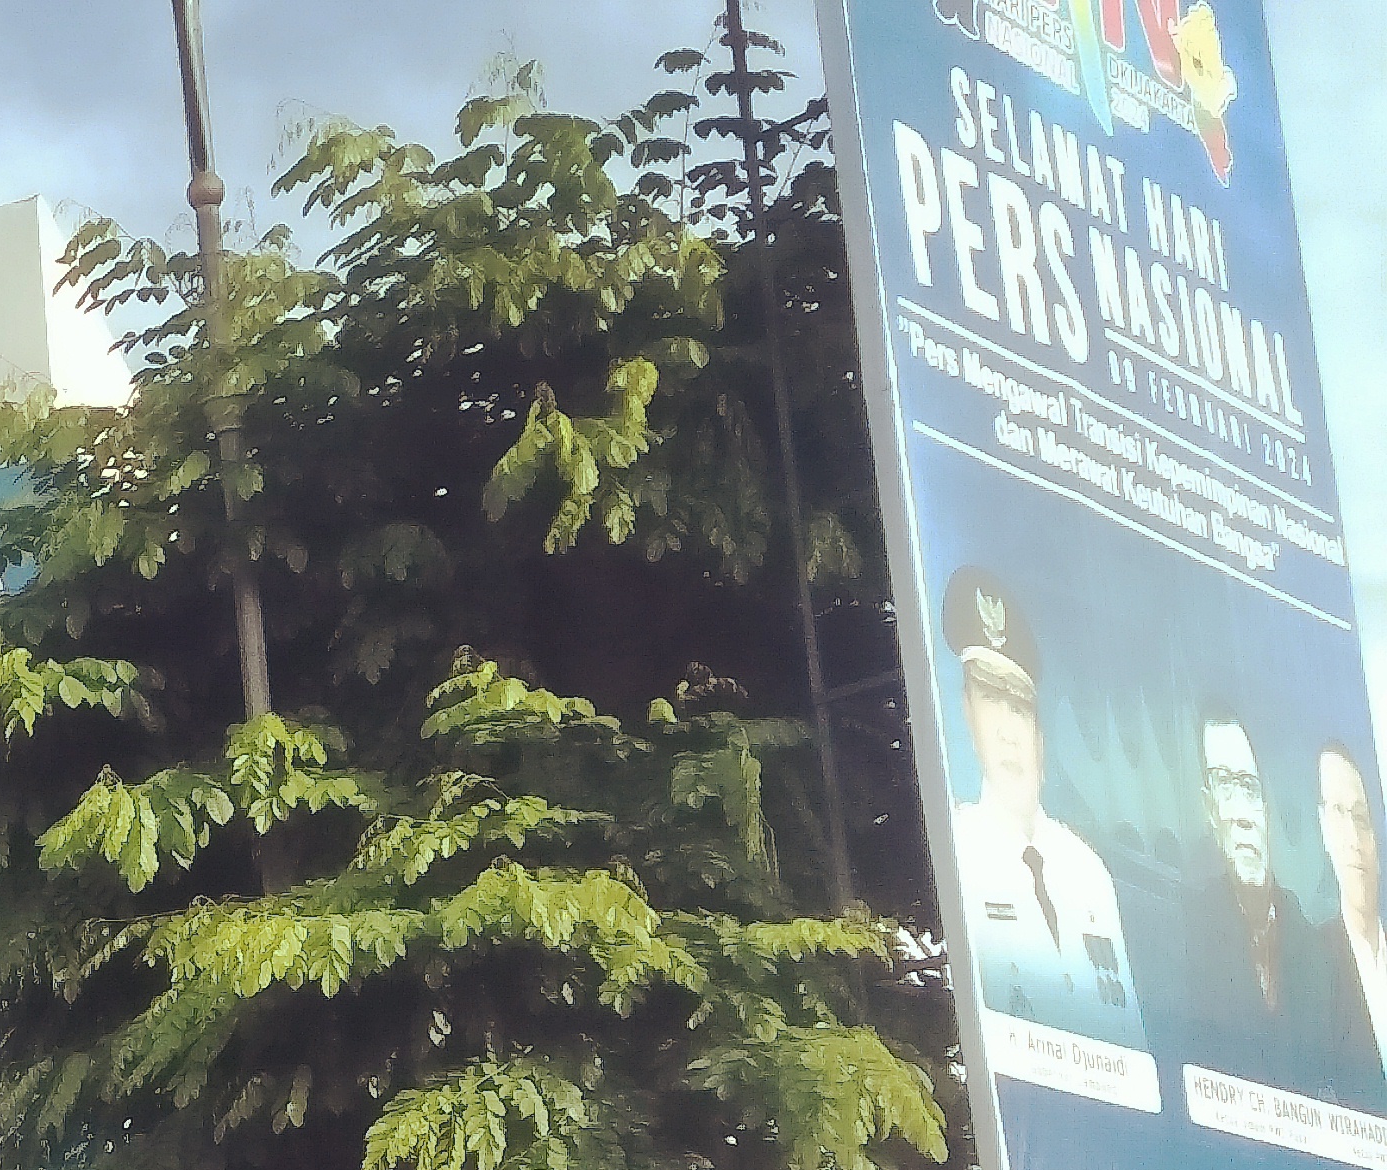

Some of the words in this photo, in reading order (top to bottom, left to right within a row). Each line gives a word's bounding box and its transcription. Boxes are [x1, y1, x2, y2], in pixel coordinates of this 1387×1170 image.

[949, 67, 1129, 233] SELAMAT
[1142, 176, 1229, 292] HARI
[892, 119, 1089, 365] PERS
[1088, 225, 1304, 427] NASIONAL
[962, 347, 1068, 427] Mengawal
[994, 409, 1035, 457] dan
[1261, 432, 1312, 487] 2024
[1028, 1030, 1067, 1060] Arinal
[1072, 1042, 1127, 1077] Djunaidi
[1194, 1075, 1243, 1106] HENDRY
[1273, 1096, 1323, 1130] BANGUN
